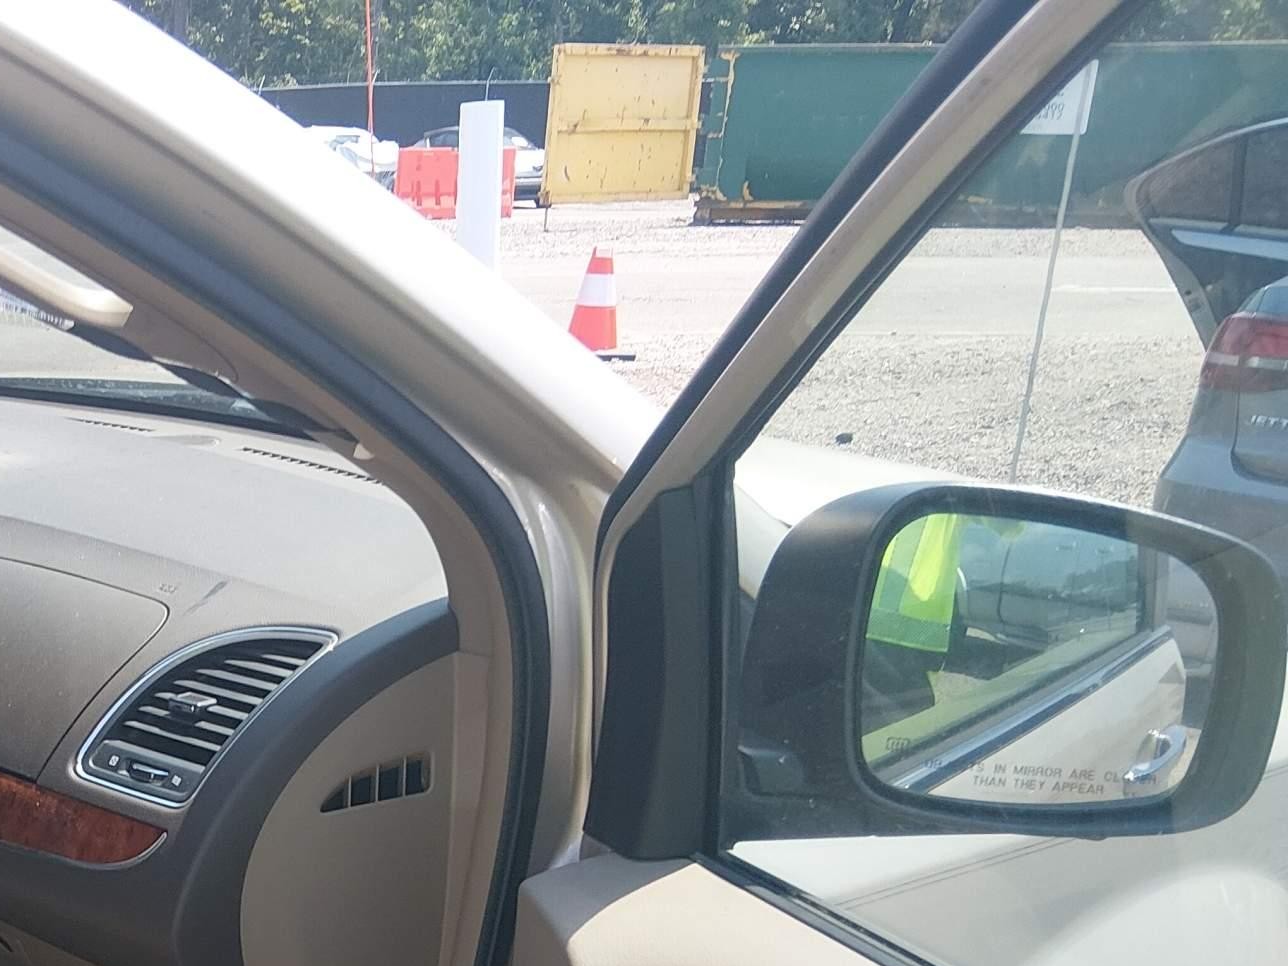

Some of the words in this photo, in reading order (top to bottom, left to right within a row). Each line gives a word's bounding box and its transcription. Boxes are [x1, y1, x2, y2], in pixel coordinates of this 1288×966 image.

[993, 763, 1008, 775] IN
[1013, 765, 1063, 778] MIRROR
[1069, 768, 1096, 781] ARE
[973, 775, 1007, 787] THAN
[1013, 779, 1047, 791] THEY
[1052, 781, 1105, 795] APPEAR
